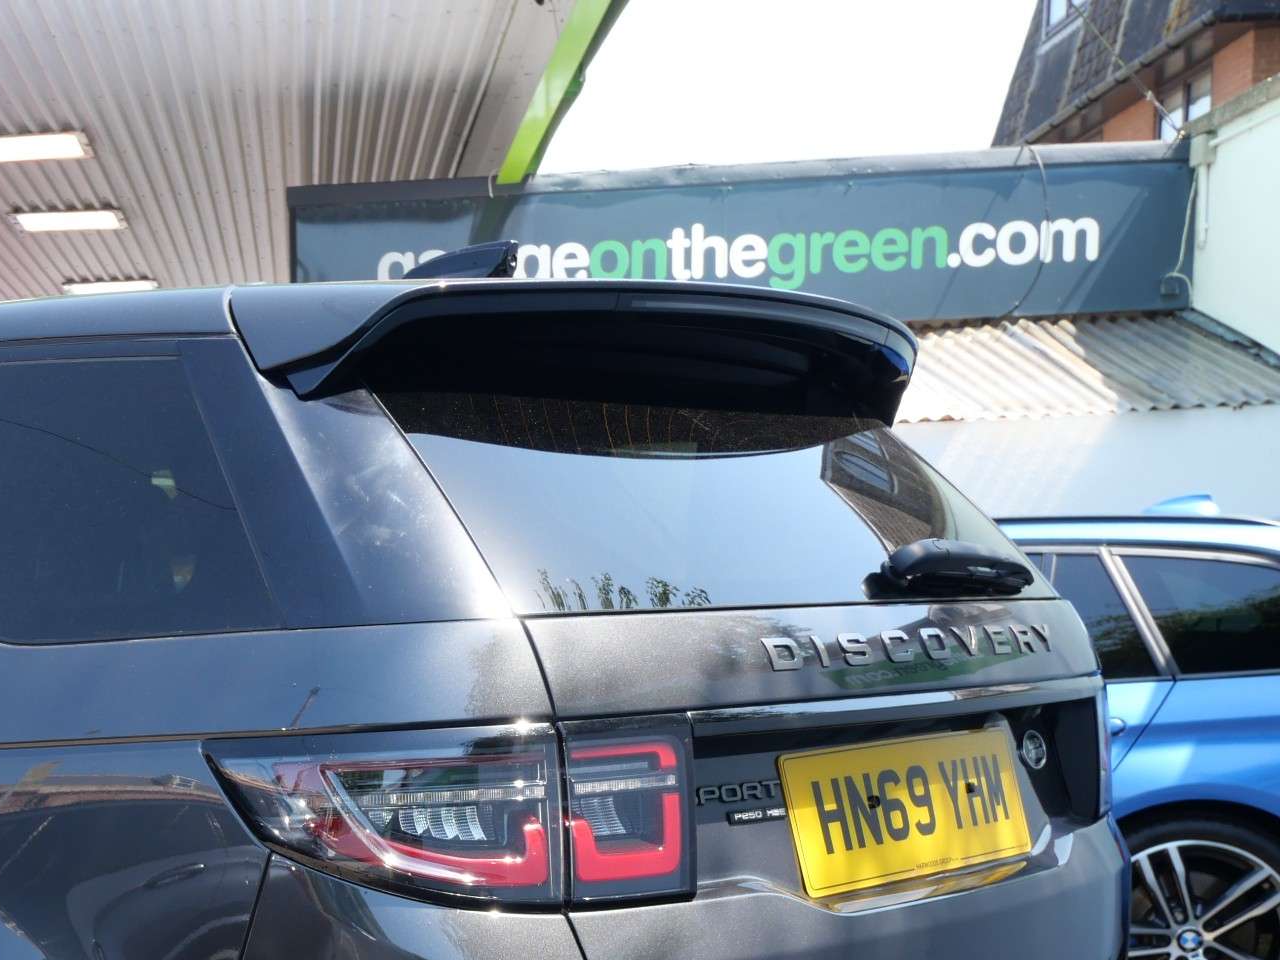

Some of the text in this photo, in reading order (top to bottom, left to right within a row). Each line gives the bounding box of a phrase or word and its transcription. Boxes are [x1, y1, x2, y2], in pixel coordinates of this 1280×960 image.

[377, 217, 1100, 291] geonthegreen.com
[760, 623, 1052, 671] DISCOVERY
[734, 810, 763, 821] P250
[811, 753, 1010, 855] HN69 YHM
